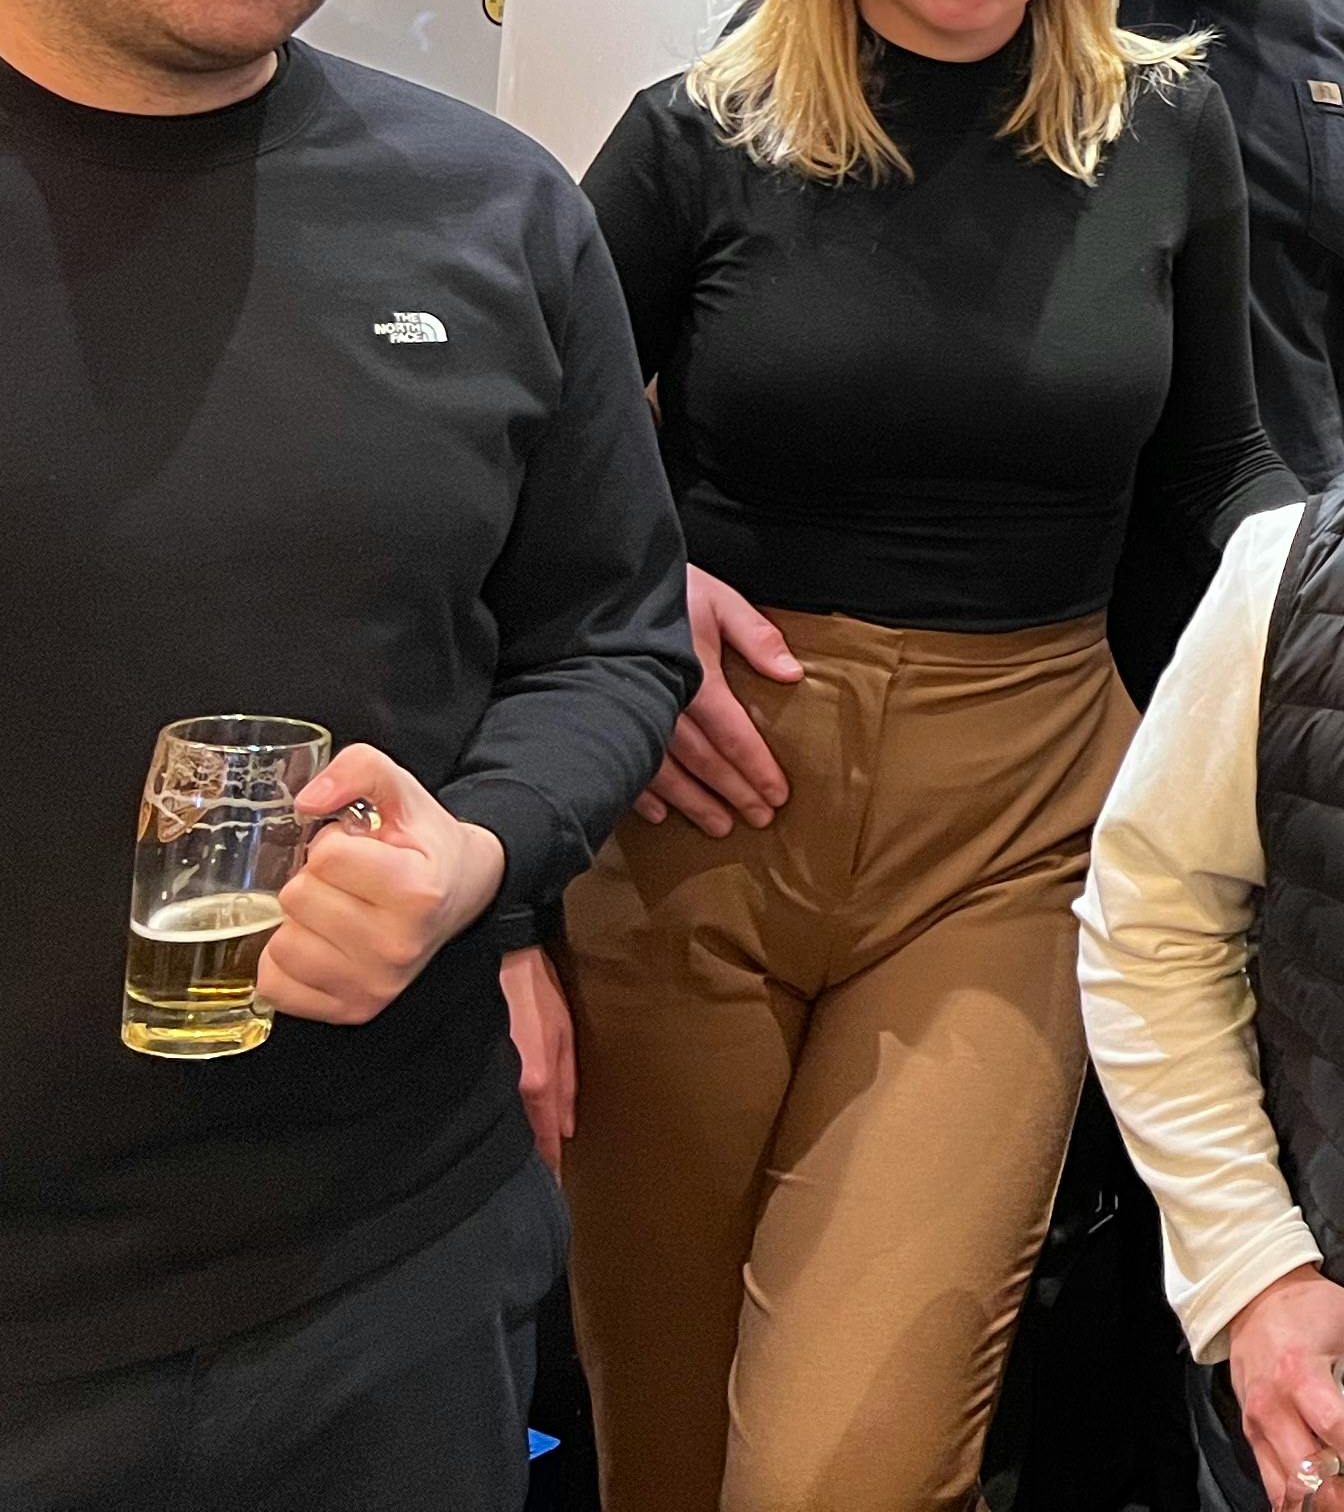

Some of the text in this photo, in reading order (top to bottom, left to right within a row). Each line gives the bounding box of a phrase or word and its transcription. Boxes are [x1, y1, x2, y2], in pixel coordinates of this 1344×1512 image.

[393, 312, 420, 323] THE
[374, 322, 421, 335] NORTH
[390, 332, 423, 344] FACE
